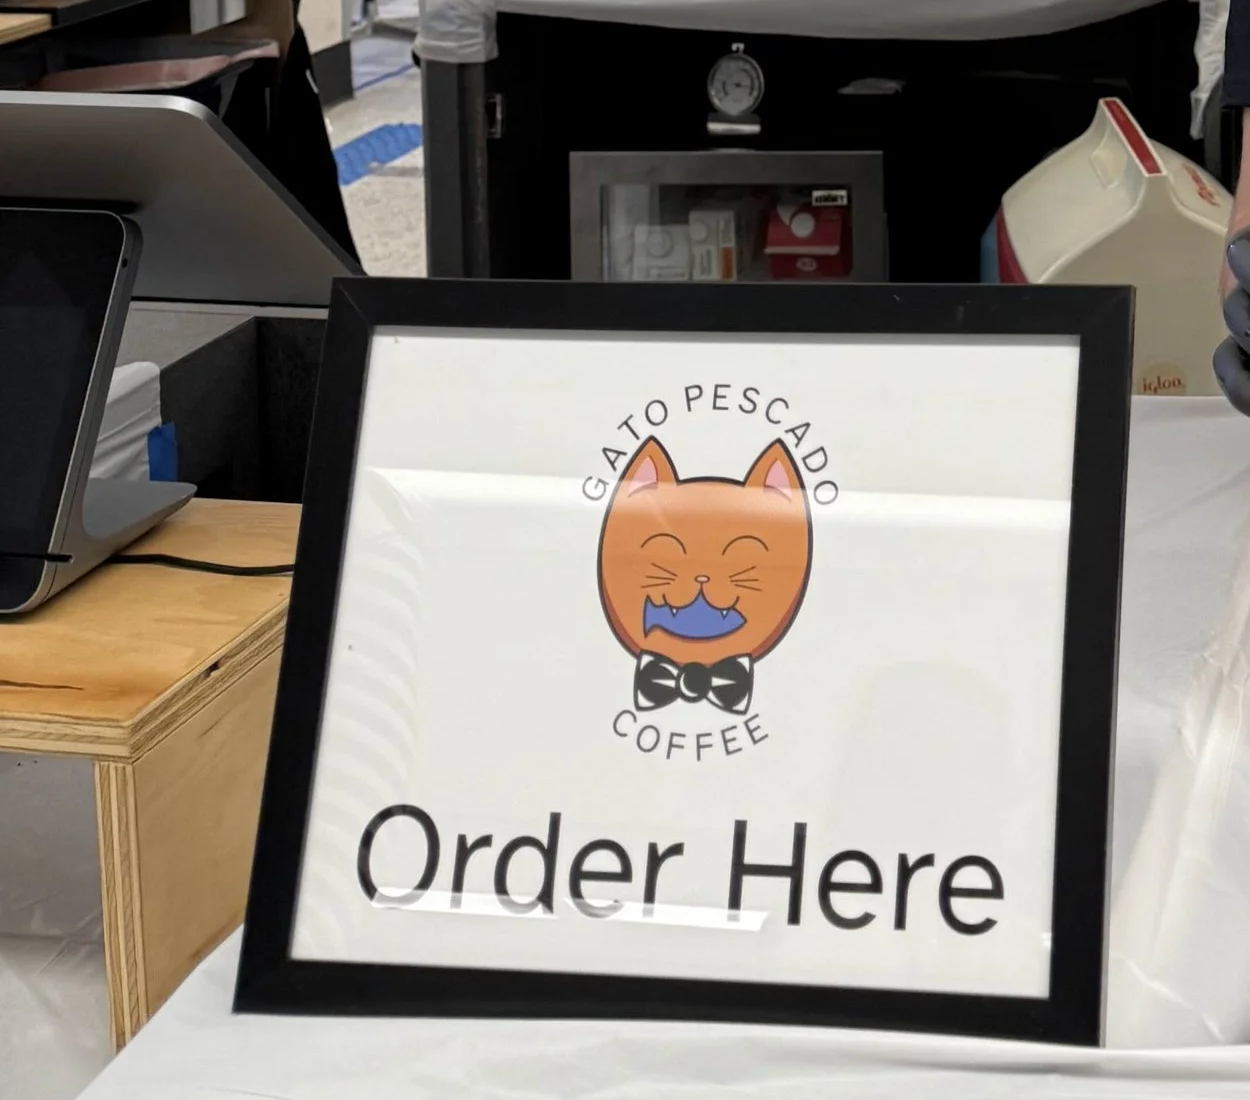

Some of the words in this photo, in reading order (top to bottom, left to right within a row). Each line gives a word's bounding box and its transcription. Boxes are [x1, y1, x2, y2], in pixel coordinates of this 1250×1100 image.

[581, 400, 669, 501] GATO
[684, 384, 839, 506] PESCADO
[612, 709, 769, 761] COFFEE
[357, 804, 684, 919] Order
[726, 819, 1005, 936] Here
